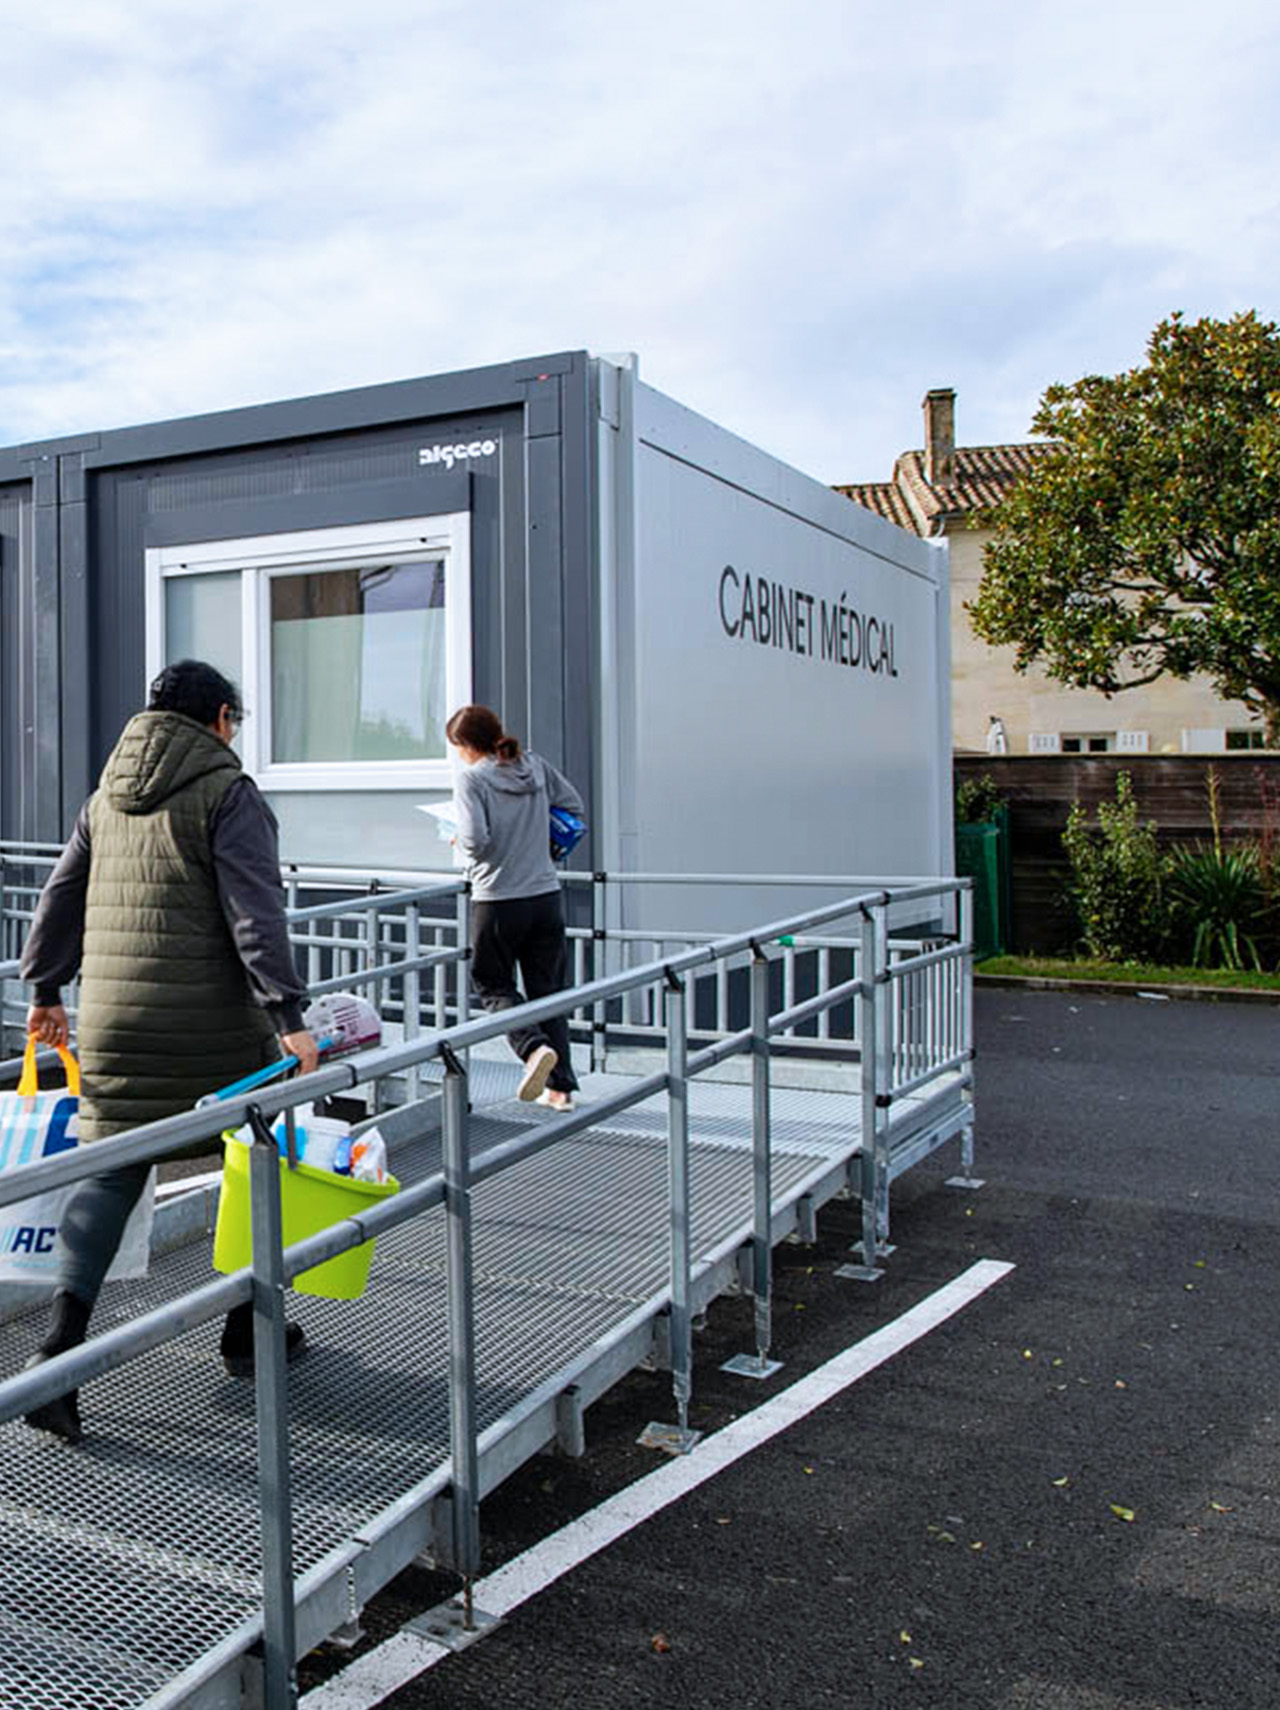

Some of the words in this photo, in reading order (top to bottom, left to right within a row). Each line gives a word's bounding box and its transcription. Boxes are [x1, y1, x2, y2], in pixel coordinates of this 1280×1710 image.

[719, 565, 814, 657] CABINET
[821, 590, 899, 677] MÉDICAL
[11, 1227, 61, 1252] AC
